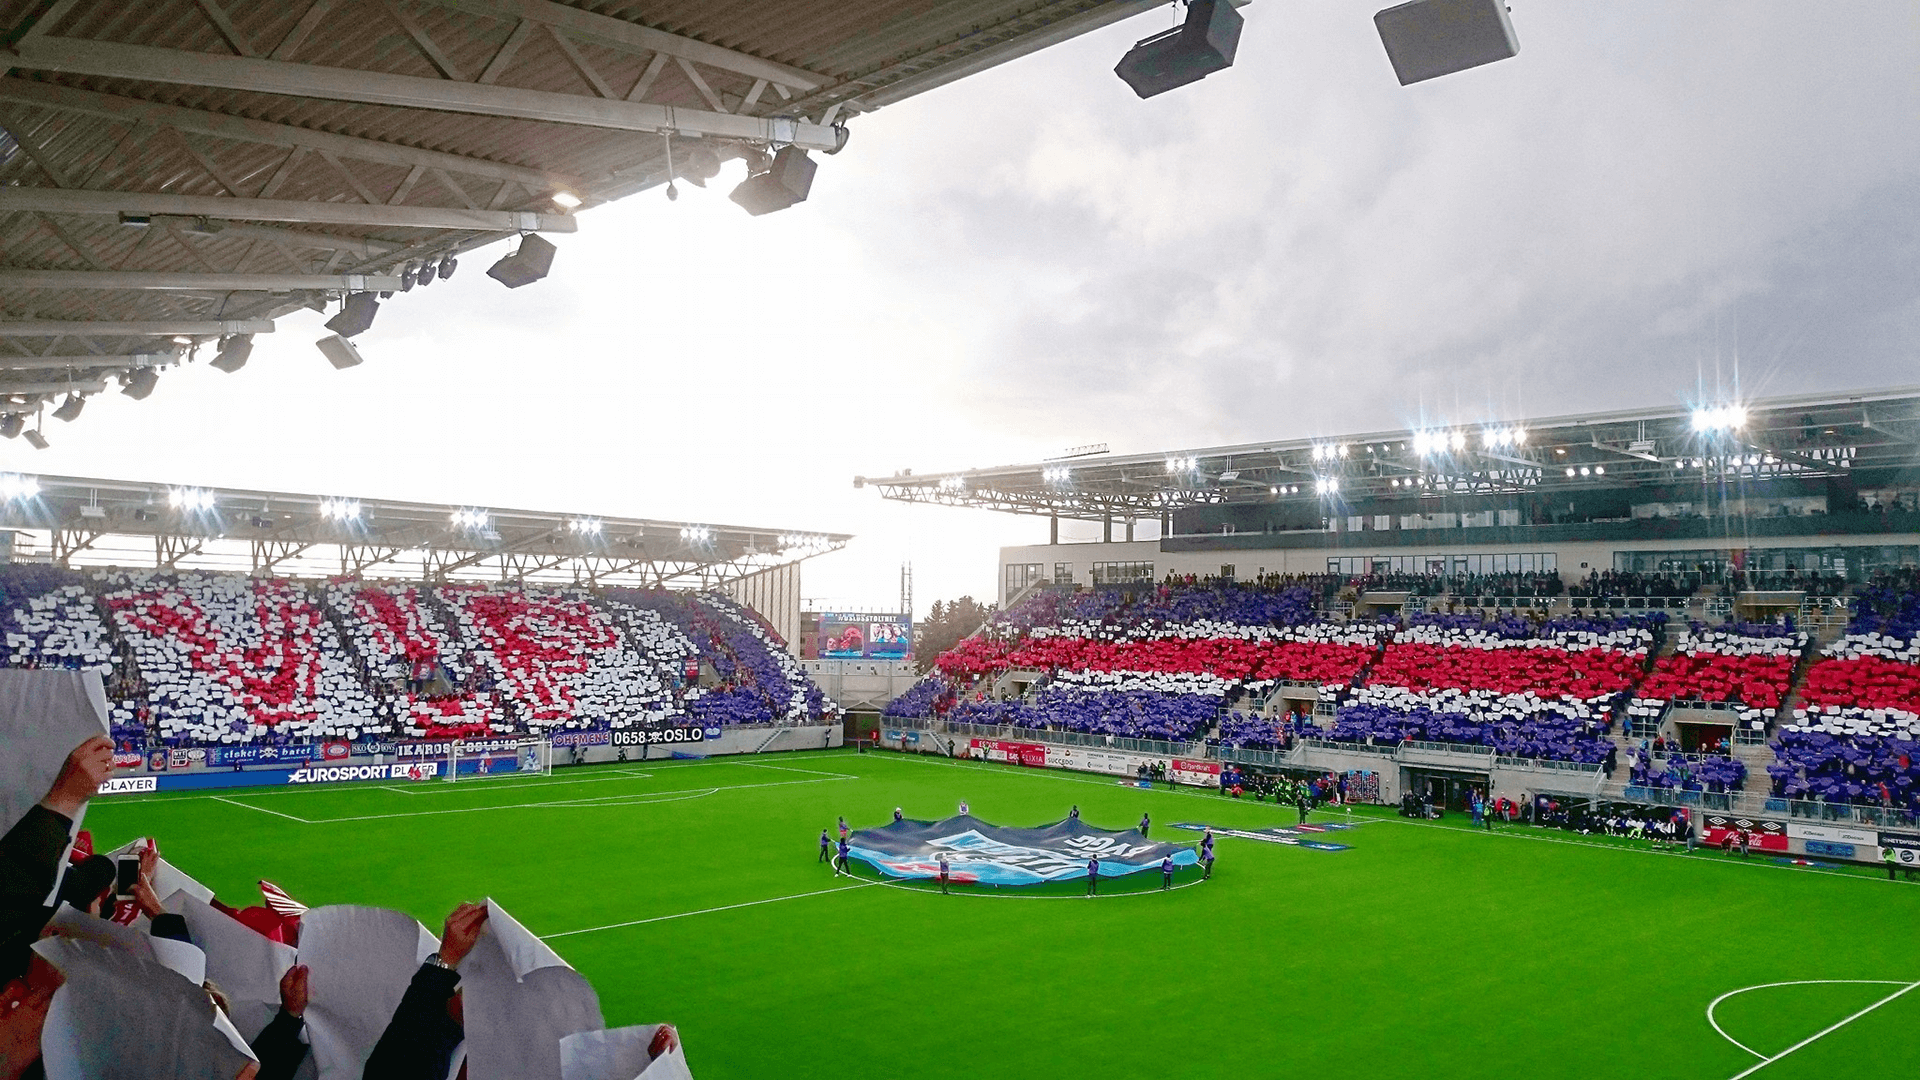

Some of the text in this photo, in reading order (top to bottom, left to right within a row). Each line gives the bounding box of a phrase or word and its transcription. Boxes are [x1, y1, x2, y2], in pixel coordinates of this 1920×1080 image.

[614, 728, 702, 745] 0658 OSLO
[398, 743, 450, 757] IKAROS
[295, 765, 389, 783] EUROSPORT
[102, 780, 153, 791] PLAYER
